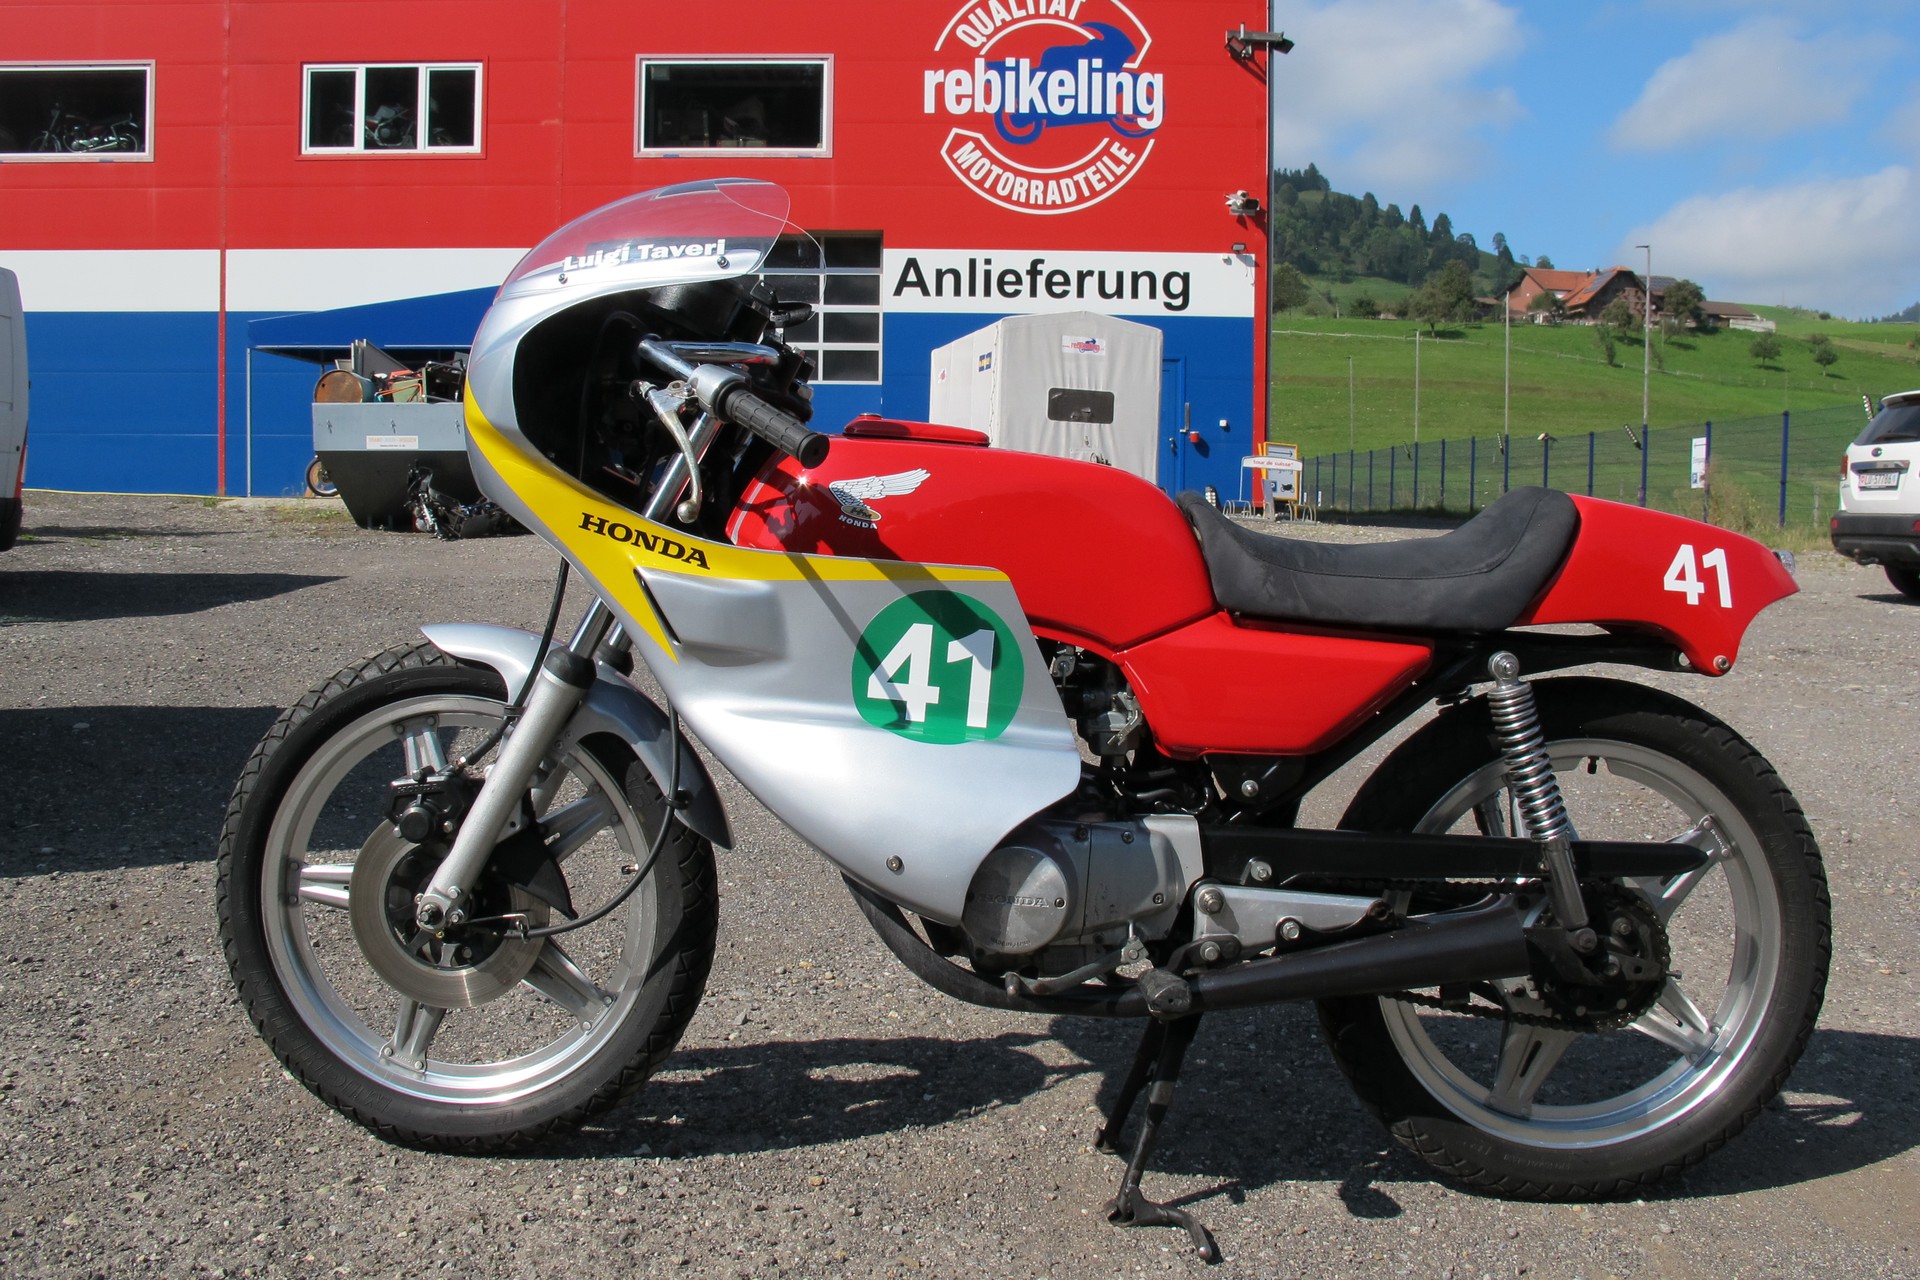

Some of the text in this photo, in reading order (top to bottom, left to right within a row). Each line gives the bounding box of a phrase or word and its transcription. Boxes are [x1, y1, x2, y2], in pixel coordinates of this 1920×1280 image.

[924, 57, 1163, 129] rebikeling
[952, 140, 1136, 205] MOTORRADTEILE
[562, 241, 630, 271] Luigi
[893, 257, 1190, 311] Anlieferung
[578, 512, 711, 570] HONDA
[839, 514, 878, 529] HONDA
[1663, 544, 1732, 608] 41
[867, 623, 996, 728] 41
